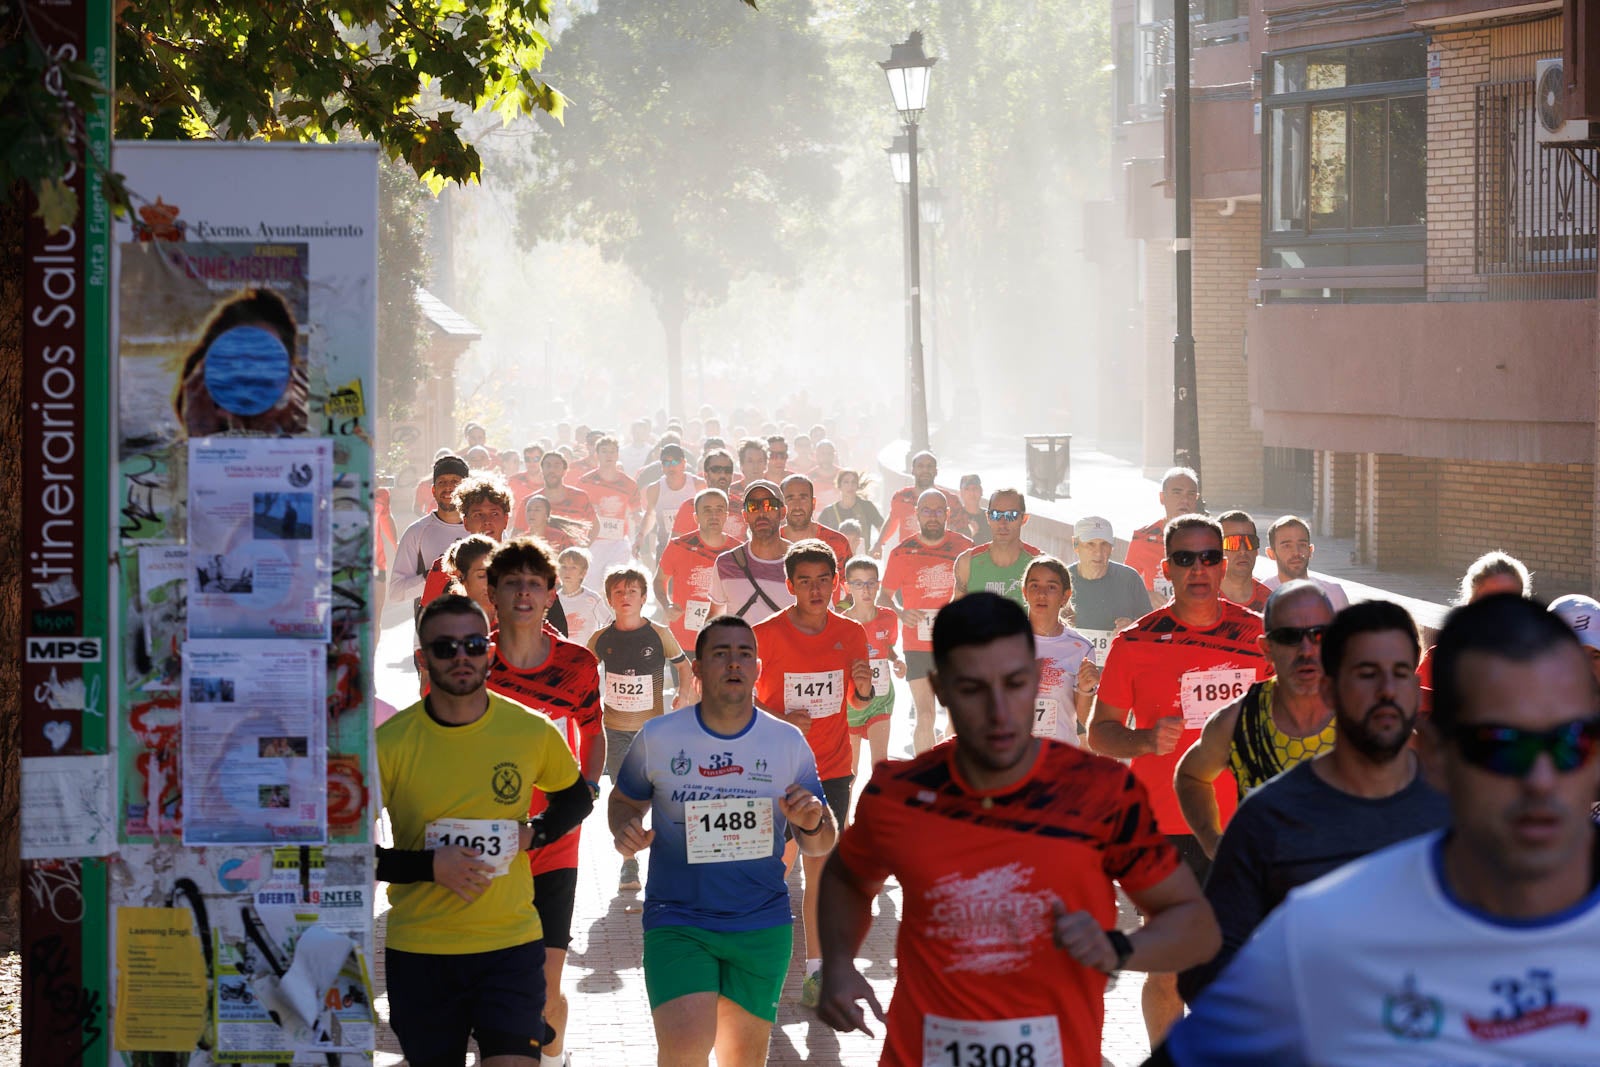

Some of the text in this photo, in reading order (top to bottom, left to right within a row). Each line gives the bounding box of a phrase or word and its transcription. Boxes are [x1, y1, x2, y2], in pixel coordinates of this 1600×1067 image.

[33, 43, 77, 328] Salues
[258, 221, 363, 241] Ayuntamiento
[29, 641, 98, 659] MPS
[611, 681, 644, 696] 1522
[793, 681, 833, 697] 1471
[1192, 682, 1244, 702] 1896
[709, 752, 734, 771] 35
[700, 811, 757, 832] 1488
[258, 892, 296, 905] OFERTA
[128, 927, 167, 938] Learning
[945, 1039, 1037, 1067] 1308
